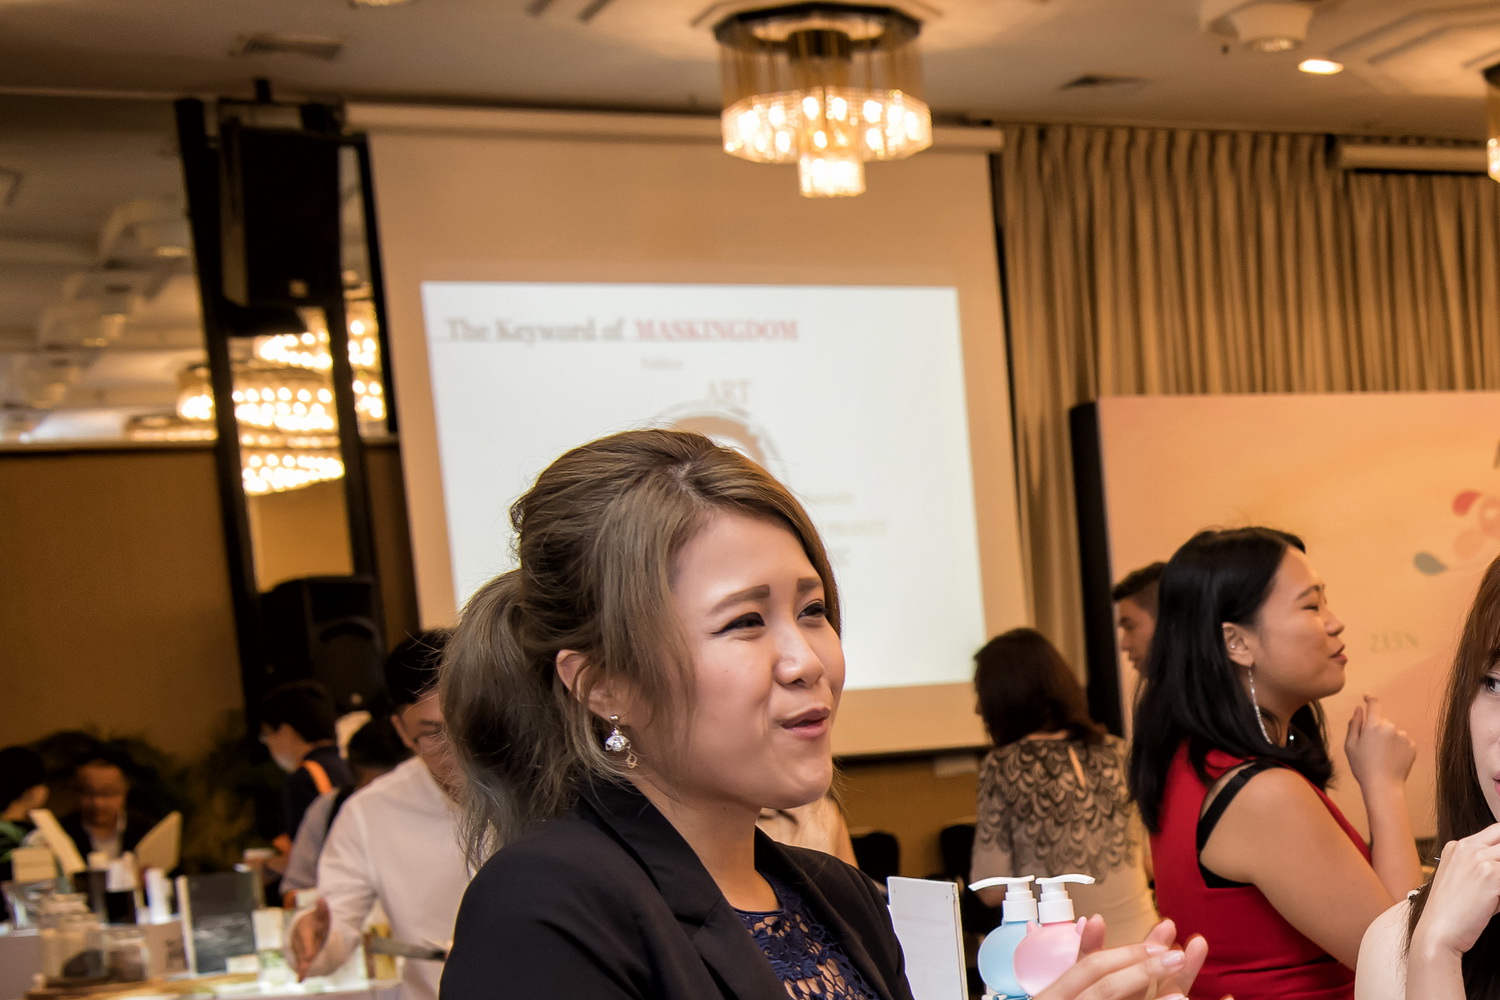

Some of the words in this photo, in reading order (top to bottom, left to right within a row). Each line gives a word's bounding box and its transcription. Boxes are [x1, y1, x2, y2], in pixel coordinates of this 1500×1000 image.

[443, 316, 490, 342] The
[495, 316, 597, 348] Keyword
[601, 313, 624, 342] of
[633, 317, 798, 342] MASKINGDOM
